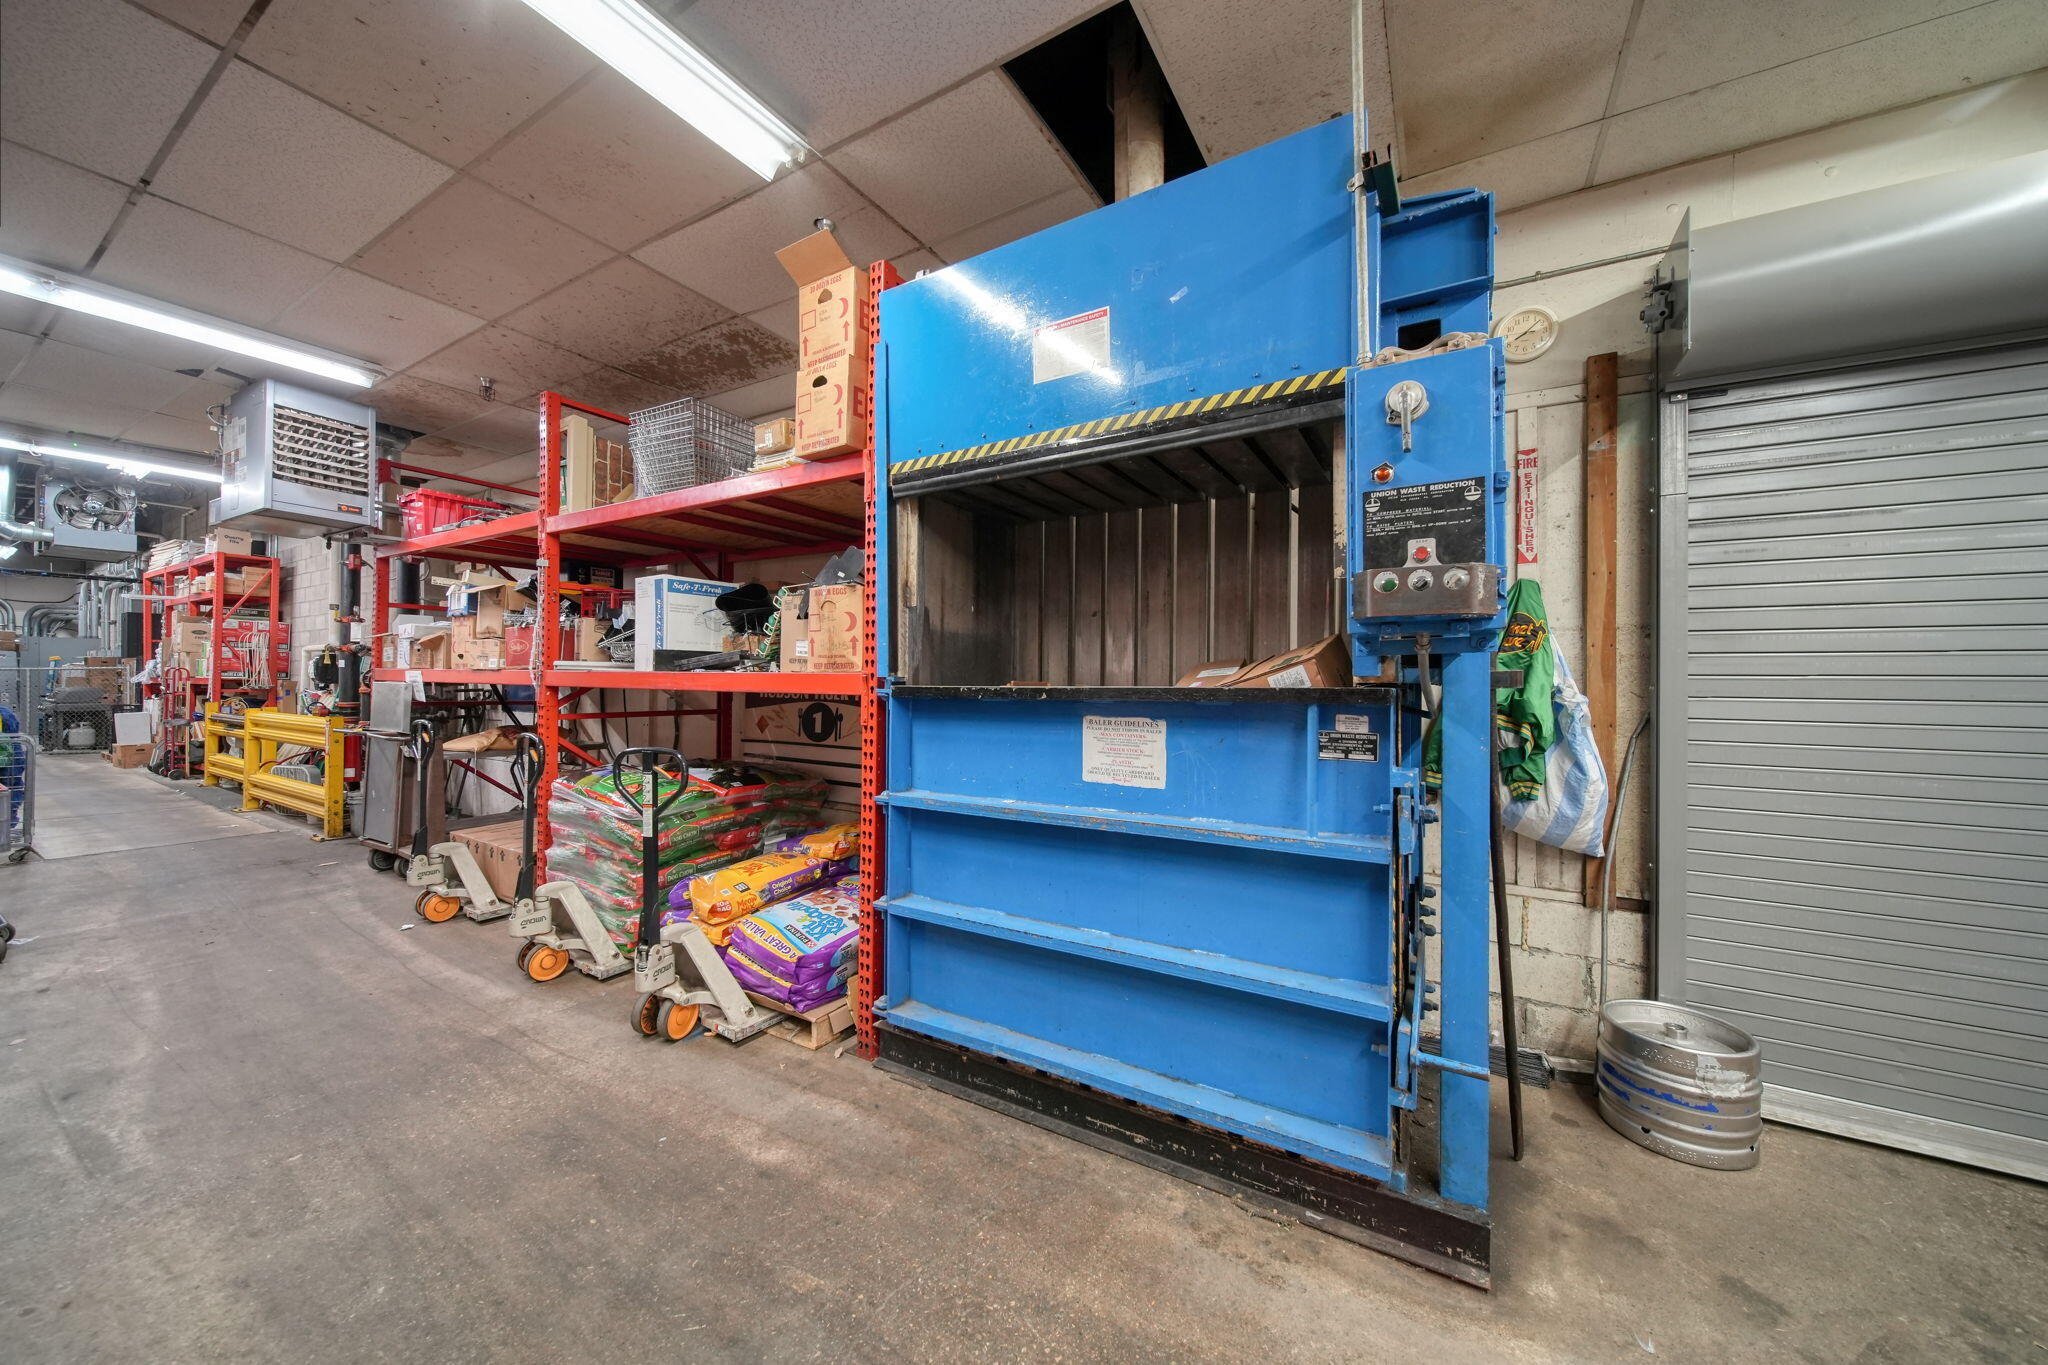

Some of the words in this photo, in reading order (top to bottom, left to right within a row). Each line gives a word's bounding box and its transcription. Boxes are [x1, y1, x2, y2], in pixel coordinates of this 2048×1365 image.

[1518, 457, 1538, 469] FIRE
[1371, 490, 1397, 498] UNION
[1400, 486, 1426, 494] WASTE
[1430, 480, 1475, 491] REDUCTION
[1524, 472, 1534, 553] EXTINGUISHER
[813, 712, 822, 733] 1
[771, 877, 793, 890] Original
[774, 885, 791, 895] Choice
[743, 919, 768, 938] VALUE
[785, 924, 811, 944] PURINA
[763, 934, 792, 956] GREAT
[789, 950, 796, 959] A
